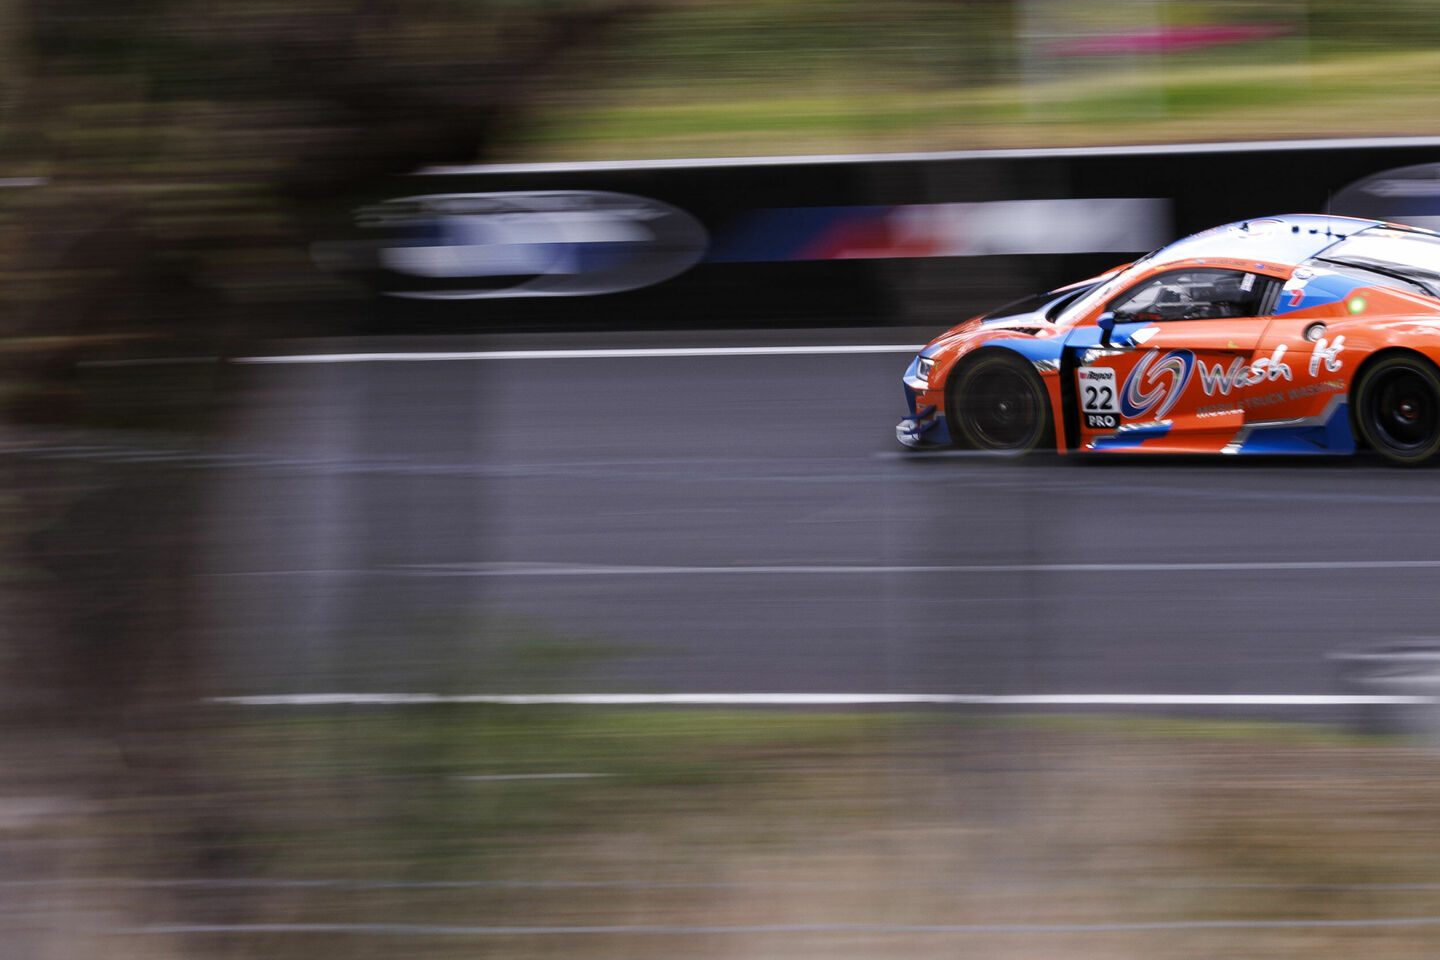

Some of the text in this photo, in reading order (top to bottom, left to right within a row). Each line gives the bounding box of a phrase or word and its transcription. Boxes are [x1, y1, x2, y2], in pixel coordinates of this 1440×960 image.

[1197, 334, 1346, 397] Wash It
[1085, 385, 1113, 410] 22
[1244, 390, 1287, 410] TRUCK
[1287, 378, 1345, 400] WASHING
[1088, 415, 1116, 427] PRO
